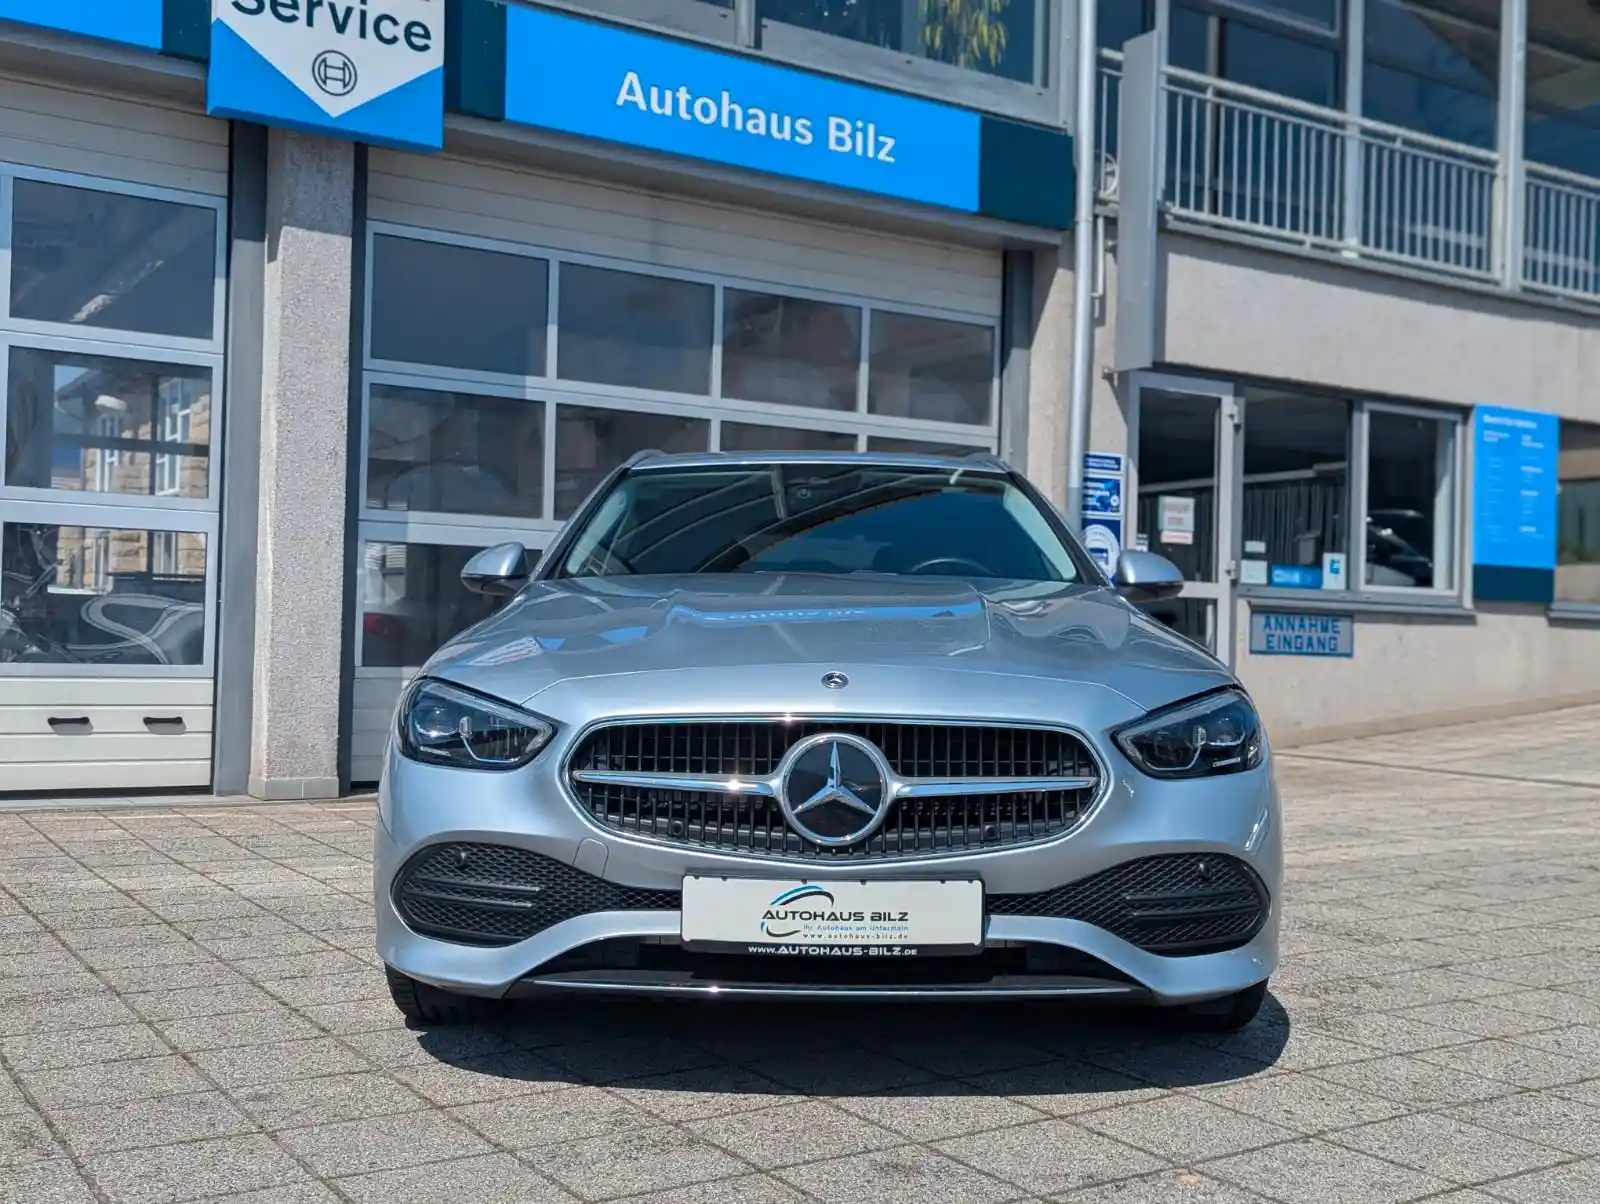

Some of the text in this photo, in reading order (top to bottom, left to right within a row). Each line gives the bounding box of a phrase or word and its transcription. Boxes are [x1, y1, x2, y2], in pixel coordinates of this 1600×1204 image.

[616, 71, 896, 163] Autohaus Bilz
[1264, 615, 1341, 634] ANNAHME
[1265, 634, 1338, 651] EINGANG
[762, 910, 909, 922] AUTOHAUS BILZ
[816, 923, 853, 932] Autohaus
[803, 931, 908, 939] www.autohaus-bilz.de
